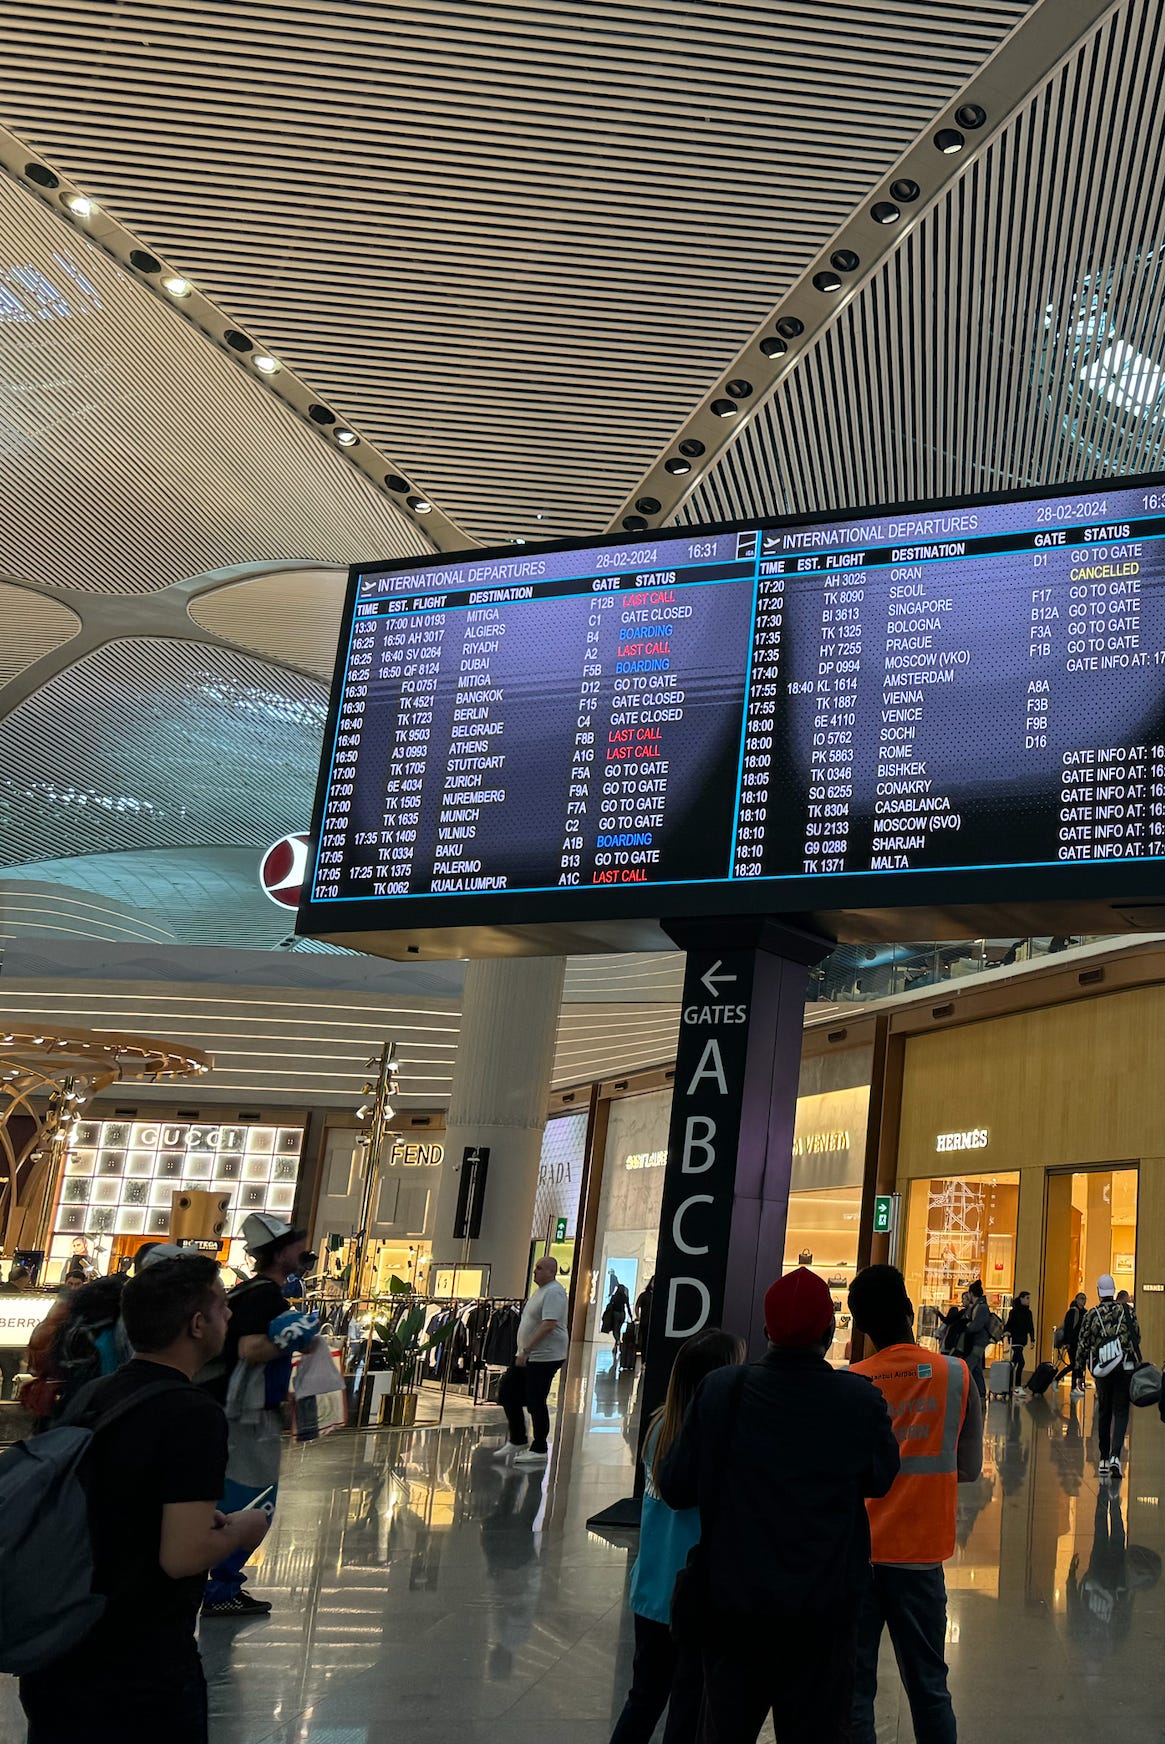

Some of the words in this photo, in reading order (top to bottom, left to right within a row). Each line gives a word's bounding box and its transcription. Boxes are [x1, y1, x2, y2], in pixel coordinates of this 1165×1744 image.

[783, 525, 884, 549] INTERNATIONAL
[888, 514, 978, 538] DEPARTURES
[1036, 500, 1107, 522] 28-02-2024
[377, 570, 465, 592] INTERNATIONAL
[467, 560, 546, 582] DEPARTURES
[595, 548, 657, 568] 28-02-2024
[687, 542, 717, 558] 16:31
[759, 560, 785, 574] TIME
[797, 557, 821, 571] EST.
[825, 552, 865, 568] FLIGHT
[891, 542, 965, 561] DESTINATION
[1034, 531, 1066, 547] GATE
[1083, 524, 1130, 541] STATUS
[354, 620, 377, 634] 13:30
[385, 617, 408, 630] 17:00
[410, 615, 423, 628] LN
[424, 613, 445, 626] 0193
[466, 608, 499, 622] MITIGA
[590, 596, 614, 610] F12B
[622, 592, 649, 607] LAST
[650, 591, 675, 604] CALL
[356, 603, 379, 616] TIME
[388, 599, 408, 612] EST.
[412, 595, 447, 610] FLIGHT
[469, 586, 533, 604] DESTINATION
[592, 577, 620, 591] GATE
[635, 571, 676, 587] STATUS
[750, 683, 776, 697] 17:55
[787, 680, 814, 694] 18:40
[817, 679, 830, 692] KL
[834, 677, 857, 691] 1614
[883, 669, 954, 687] AMSTERDAM
[1066, 656, 1098, 672] GATE
[1101, 654, 1129, 669] INFO
[1131, 652, 1150, 666] AT:
[335, 750, 358, 763] 16:50
[391, 746, 405, 759] A3
[405, 744, 427, 758] 0993
[448, 740, 488, 755] ATHENS
[575, 731, 594, 745] F8B
[608, 728, 634, 743] LAST
[636, 727, 661, 741] CALL
[737, 826, 764, 840] 18:10
[805, 822, 822, 836] SU
[823, 821, 849, 835] 2133
[873, 816, 927, 832] MOSCOW
[929, 814, 961, 831] (SVO)
[1059, 806, 1092, 821] GATE
[1095, 804, 1124, 819] INFO
[1126, 803, 1146, 818] AT:
[315, 885, 338, 898] 17:10
[373, 882, 386, 895] TK
[386, 881, 409, 894] 0062
[430, 878, 463, 892] KUALA
[464, 876, 507, 890] LUMPUR
[558, 872, 580, 885] A1C
[593, 869, 620, 884] LAST
[621, 869, 647, 882] CALL
[684, 1005, 747, 1025] GATES
[687, 1039, 728, 1095] A
[140, 1128, 235, 1147] GUCCI
[389, 1143, 445, 1166] FEND
[682, 1116, 716, 1173] B
[539, 1162, 571, 1186] RADA
[673, 1195, 714, 1254] C
[0, 1317, 41, 1328] BERR
[665, 1277, 710, 1337] D
